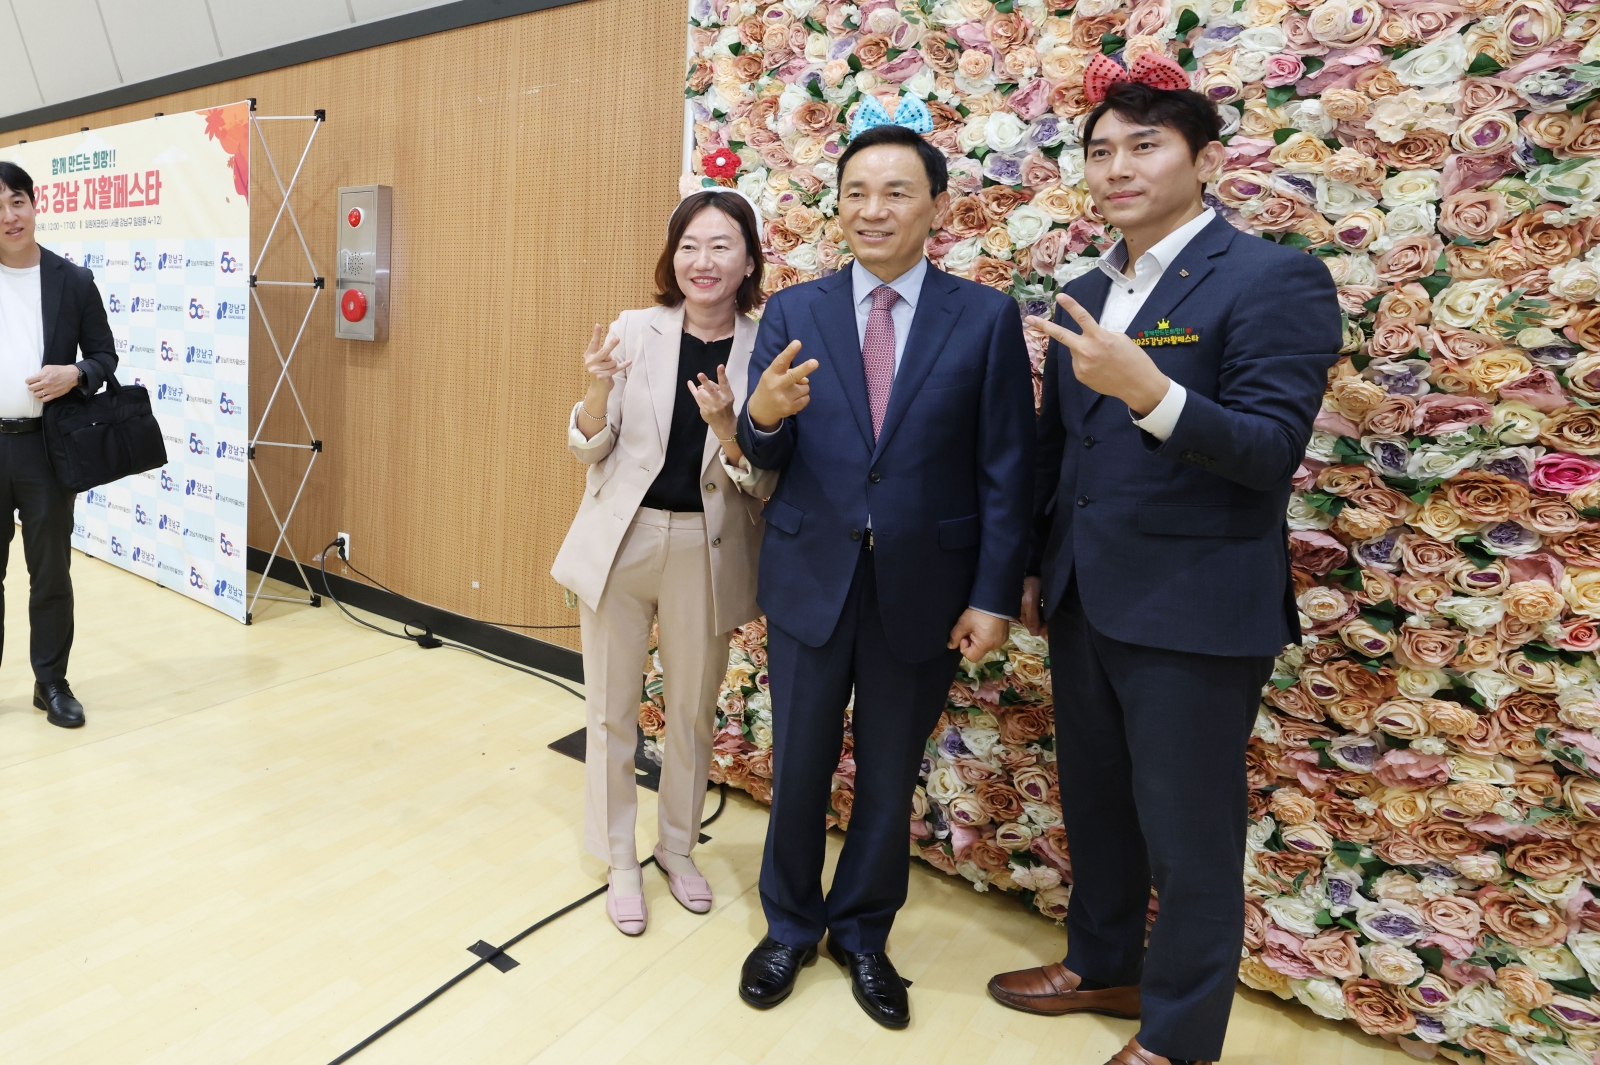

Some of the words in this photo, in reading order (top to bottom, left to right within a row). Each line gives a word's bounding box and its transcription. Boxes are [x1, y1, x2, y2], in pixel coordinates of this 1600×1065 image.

[51, 157, 66, 175] 함께
[68, 153, 90, 173] 만드는
[92, 149, 116, 170] 희망!!
[52, 179, 79, 214] 강남
[83, 170, 162, 210] 자활페스타
[120, 216, 132, 227] 강남구
[168, 254, 183, 264] 강남구
[141, 298, 154, 307] 강남구
[228, 303, 246, 315] 강남구
[196, 348, 213, 359] 강남구
[168, 386, 183, 397] 강남구
[228, 444, 245, 457] 강남구
[197, 482, 213, 495] 강남구
[227, 584, 243, 599] 강남구
